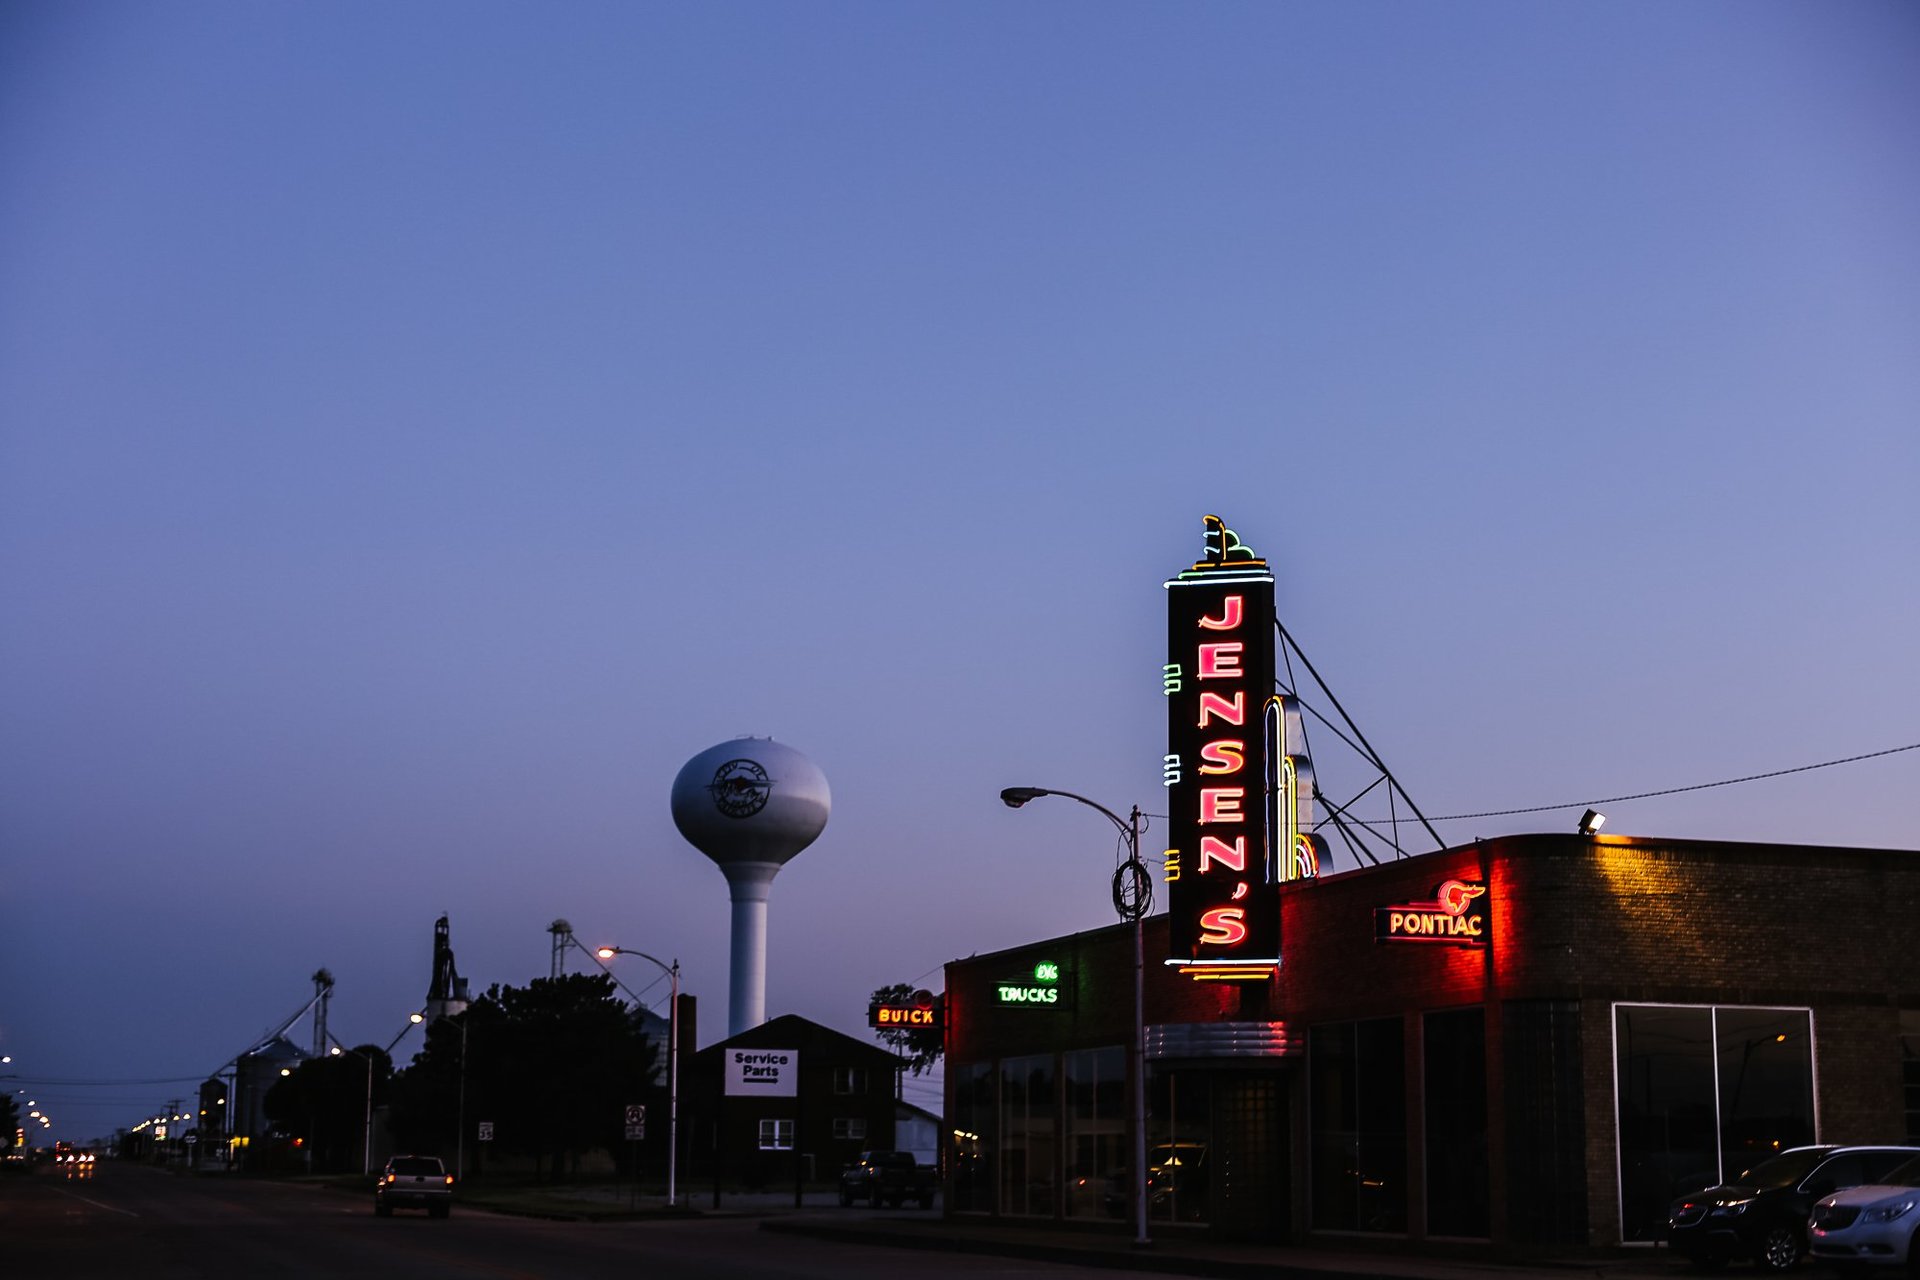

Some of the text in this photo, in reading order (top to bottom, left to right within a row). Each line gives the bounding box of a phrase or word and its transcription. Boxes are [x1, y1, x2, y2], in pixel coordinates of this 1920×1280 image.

[1197, 595, 1246, 946] JENSEN'S
[1390, 912, 1482, 936] PONTIAC
[998, 987, 1058, 1003] TRUCKS
[878, 1008, 933, 1024] BUICK
[735, 1052, 789, 1065] Service
[743, 1065, 779, 1077] Parts
